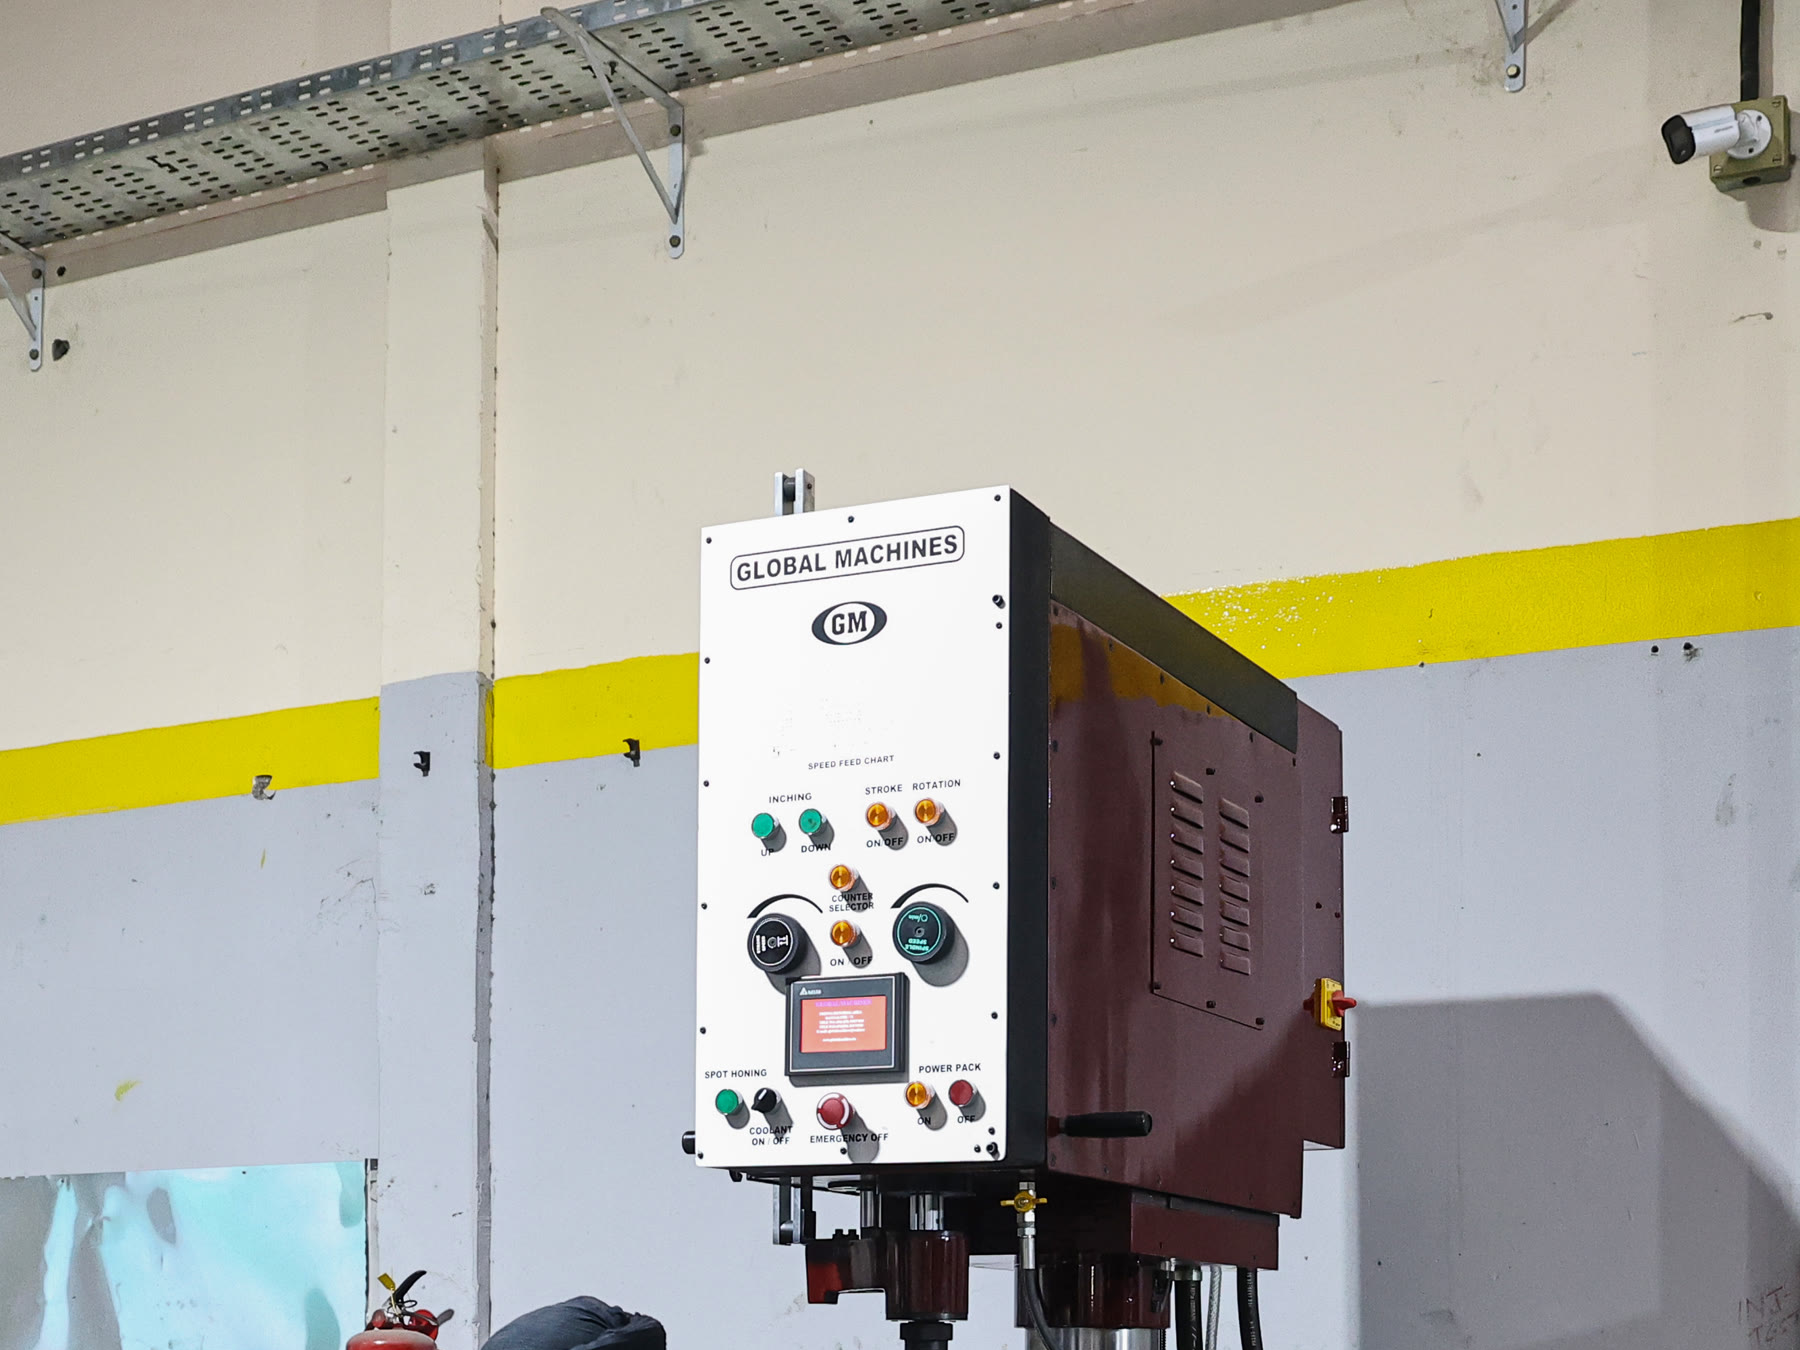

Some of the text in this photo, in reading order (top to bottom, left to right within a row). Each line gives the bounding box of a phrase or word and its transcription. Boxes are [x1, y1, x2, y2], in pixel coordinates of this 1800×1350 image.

[737, 534, 958, 582] GLOBAL MACHINES
[831, 611, 868, 635] GM
[808, 755, 894, 770] SPEED FEED CHART
[865, 779, 961, 795] STROKE ROTATION
[769, 792, 812, 803] INCHING
[761, 848, 774, 856] UP
[801, 843, 831, 852] DOWN
[832, 892, 873, 902] COUNTER
[829, 902, 874, 912] SELECTOR
[830, 956, 872, 966] ON OFF
[919, 1063, 982, 1073] POWER PACK
[705, 1069, 767, 1078] SPOT HONING
[918, 1116, 931, 1125] ON
[958, 1115, 976, 1124] OFF
[749, 1126, 793, 1135] COOLANT
[752, 1138, 765, 1146] ON
[773, 1137, 790, 1145] OFF
[810, 1133, 888, 1144] EMERGENCY OFF
